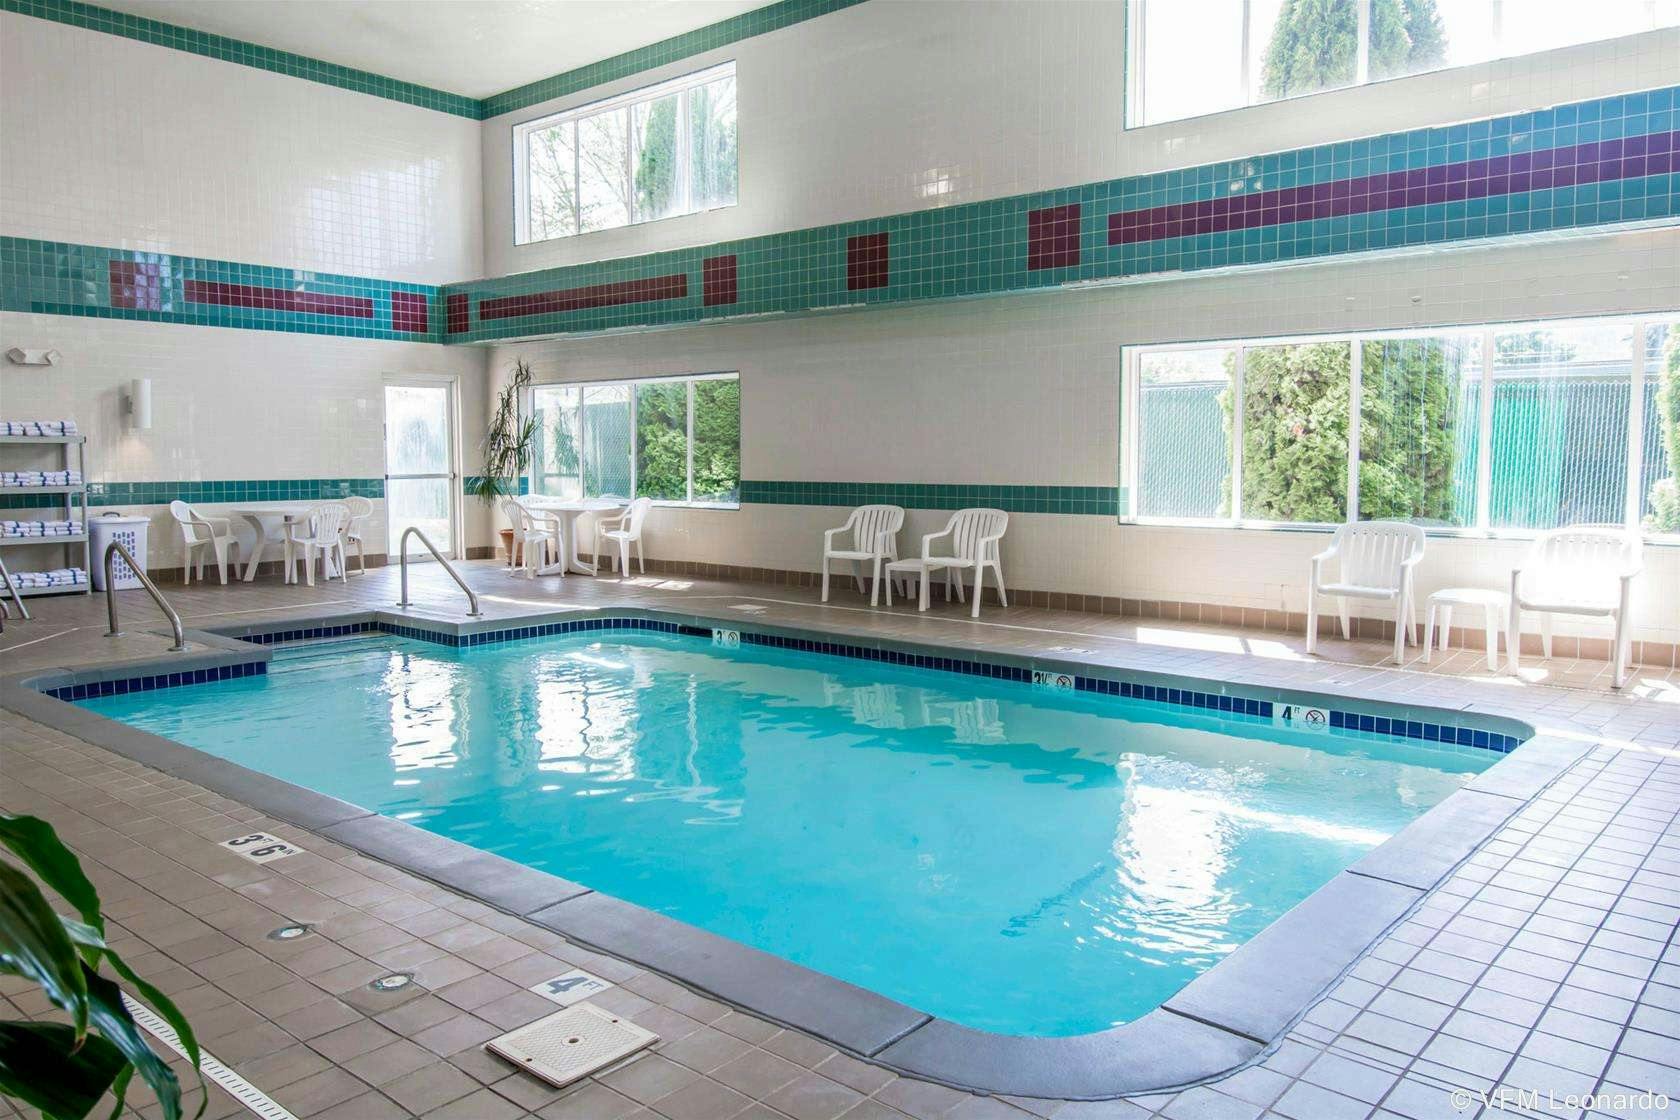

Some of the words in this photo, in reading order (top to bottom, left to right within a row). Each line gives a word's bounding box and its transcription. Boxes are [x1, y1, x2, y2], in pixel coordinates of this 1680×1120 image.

[1282, 705, 1292, 720] 4
[1294, 706, 1301, 714] FT
[228, 834, 265, 846] 3
[250, 844, 287, 857] 6
[547, 976, 589, 995] 4
[582, 980, 604, 991] FT
